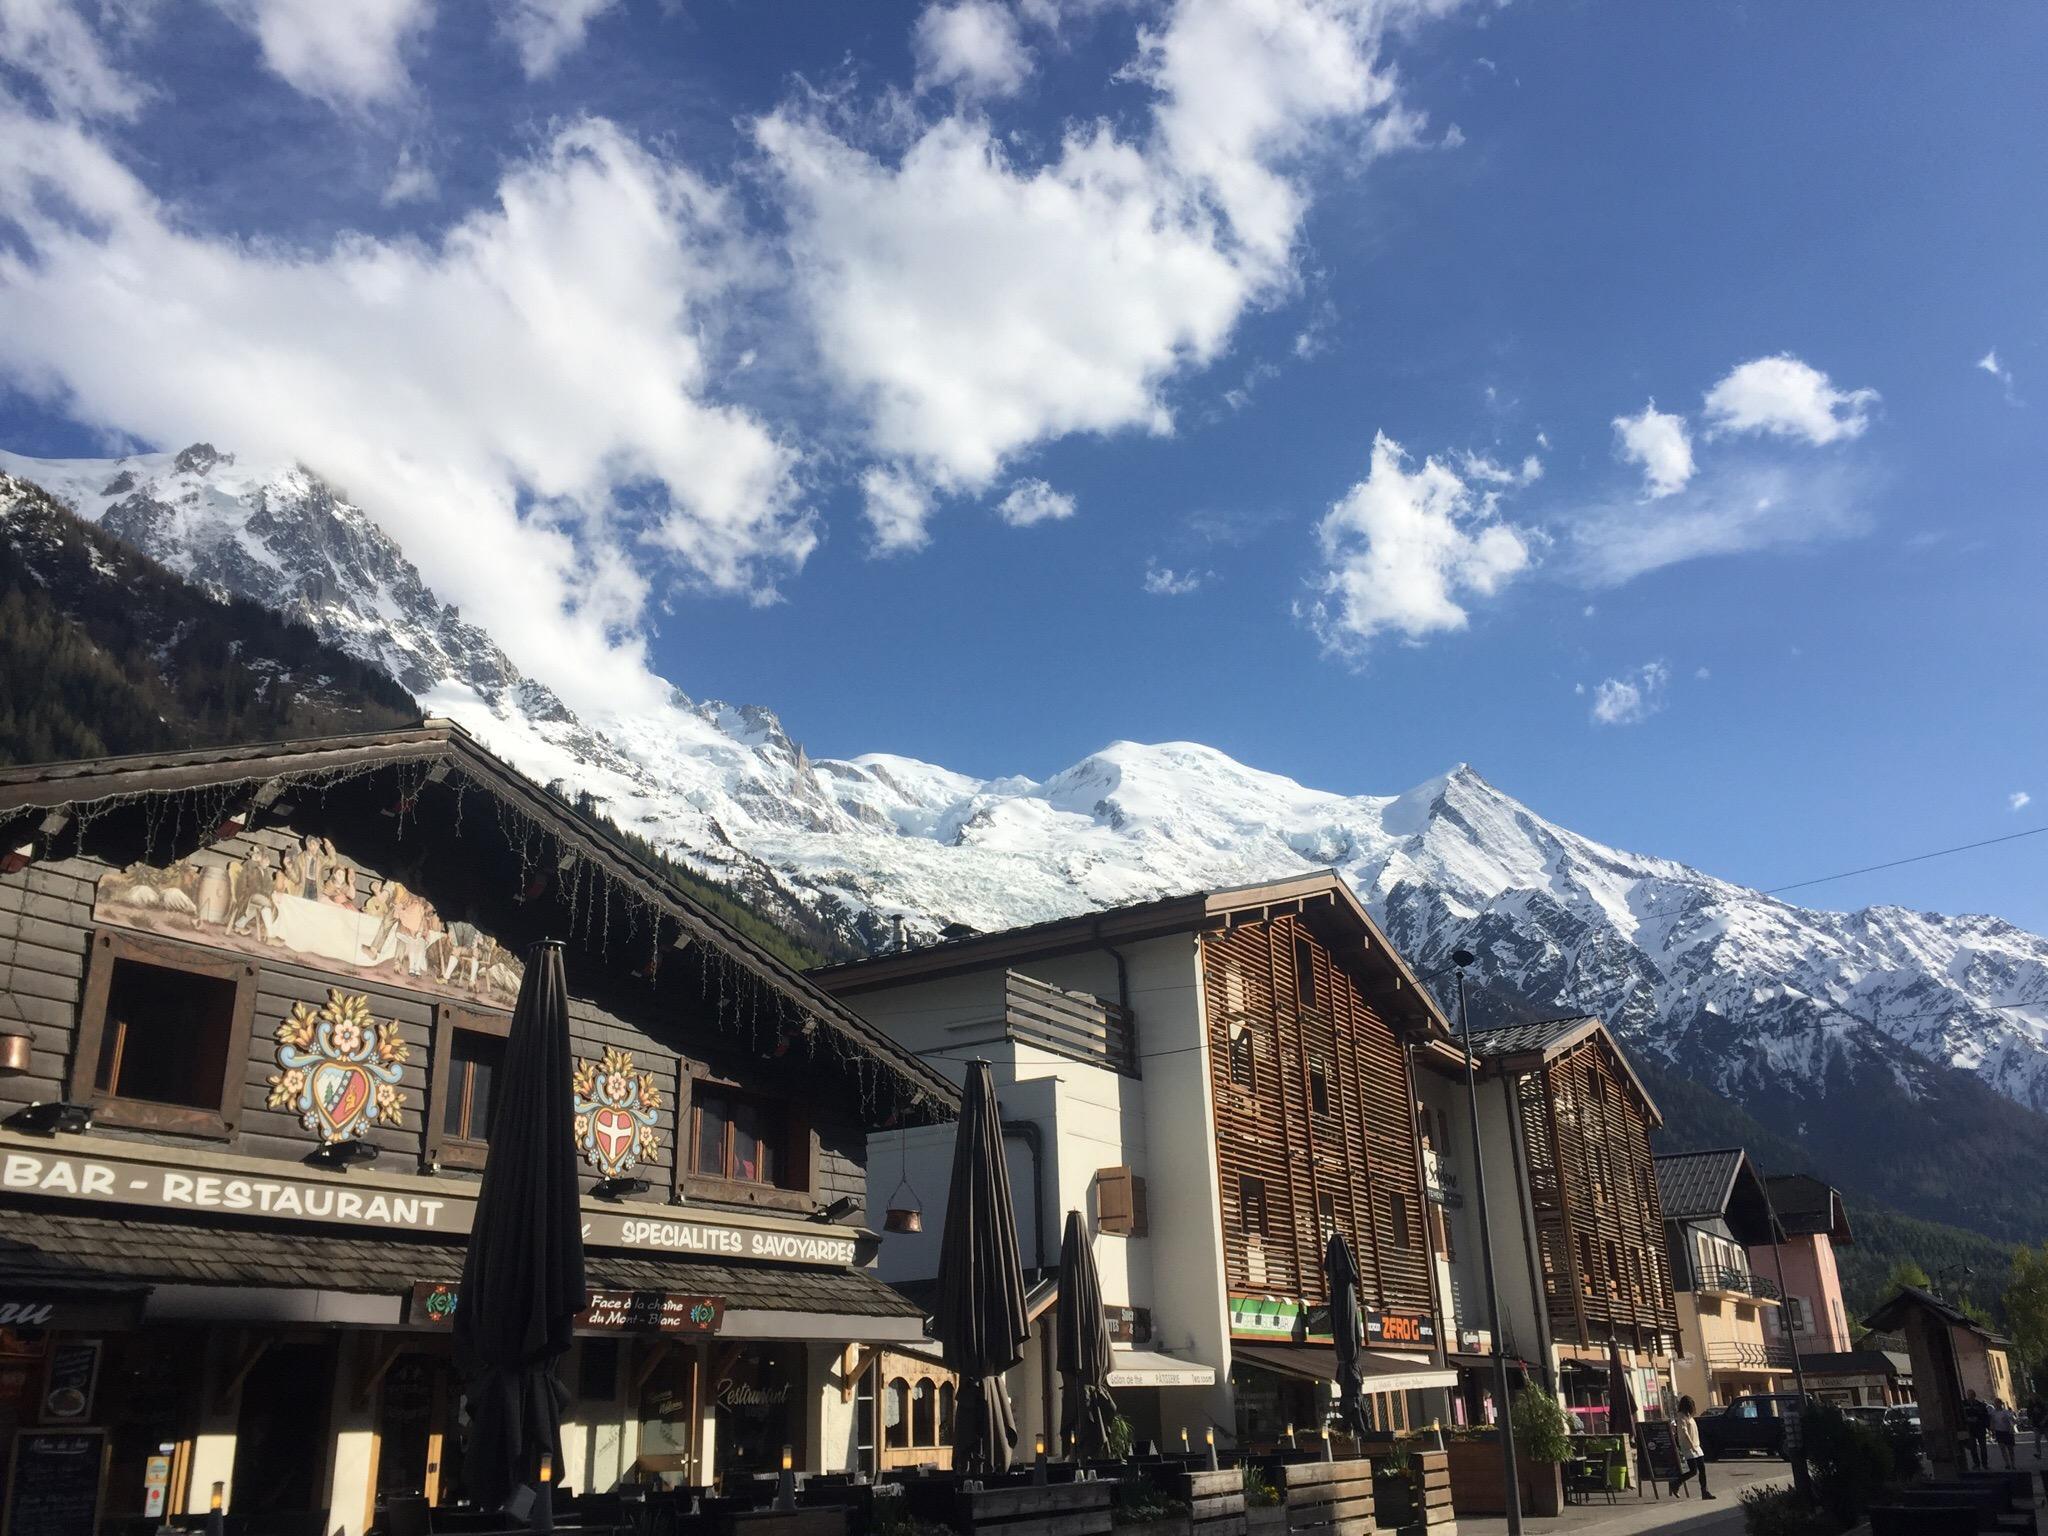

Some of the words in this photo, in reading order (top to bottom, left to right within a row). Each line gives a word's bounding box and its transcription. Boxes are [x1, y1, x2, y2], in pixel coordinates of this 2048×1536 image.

[3, 1155, 116, 1195] BAR
[162, 1173, 444, 1226] RESTAURANT
[621, 1221, 743, 1252] SPECIALITES
[751, 1234, 857, 1263] SAVOYARDES
[591, 1294, 622, 1309] Face
[624, 1297, 631, 1309] à
[634, 1296, 644, 1309] la
[647, 1298, 684, 1311] chaîne
[588, 1310, 604, 1323] du
[605, 1311, 638, 1325] Mont
[648, 1313, 681, 1326] Blanc
[1382, 1316, 1411, 1340] ZERO
[1411, 1319, 1420, 1342] G
[717, 1378, 792, 1413] Restaurant
